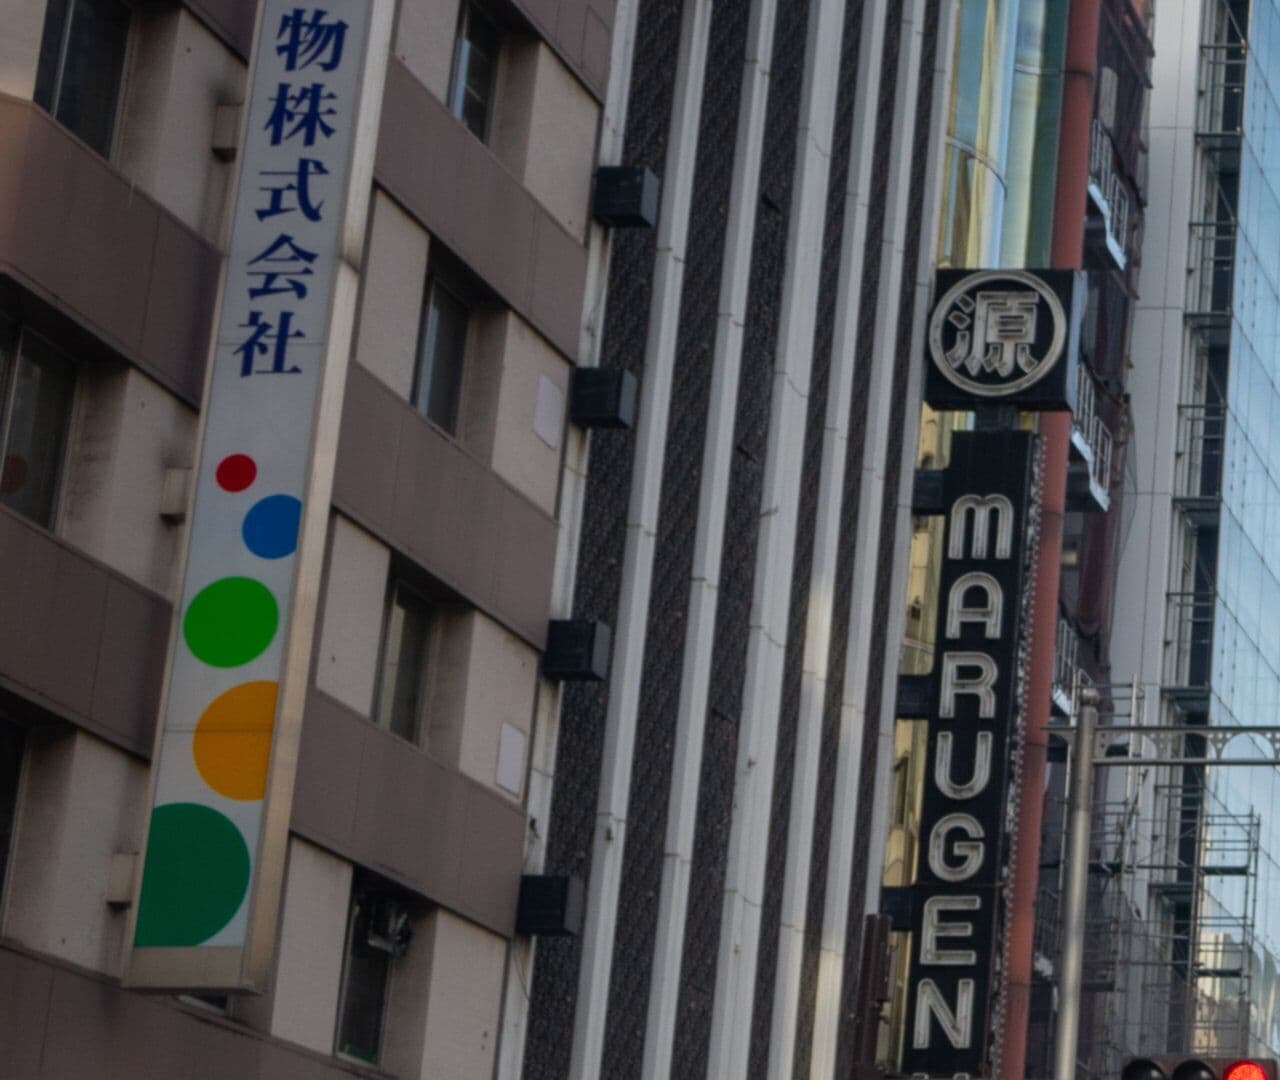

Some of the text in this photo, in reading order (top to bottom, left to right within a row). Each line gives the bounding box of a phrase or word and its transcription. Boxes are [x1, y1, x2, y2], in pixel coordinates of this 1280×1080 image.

[232, 8, 348, 377] 物株式会社
[944, 291, 1040, 377] 源
[912, 494, 1014, 1050] MARUGEN
